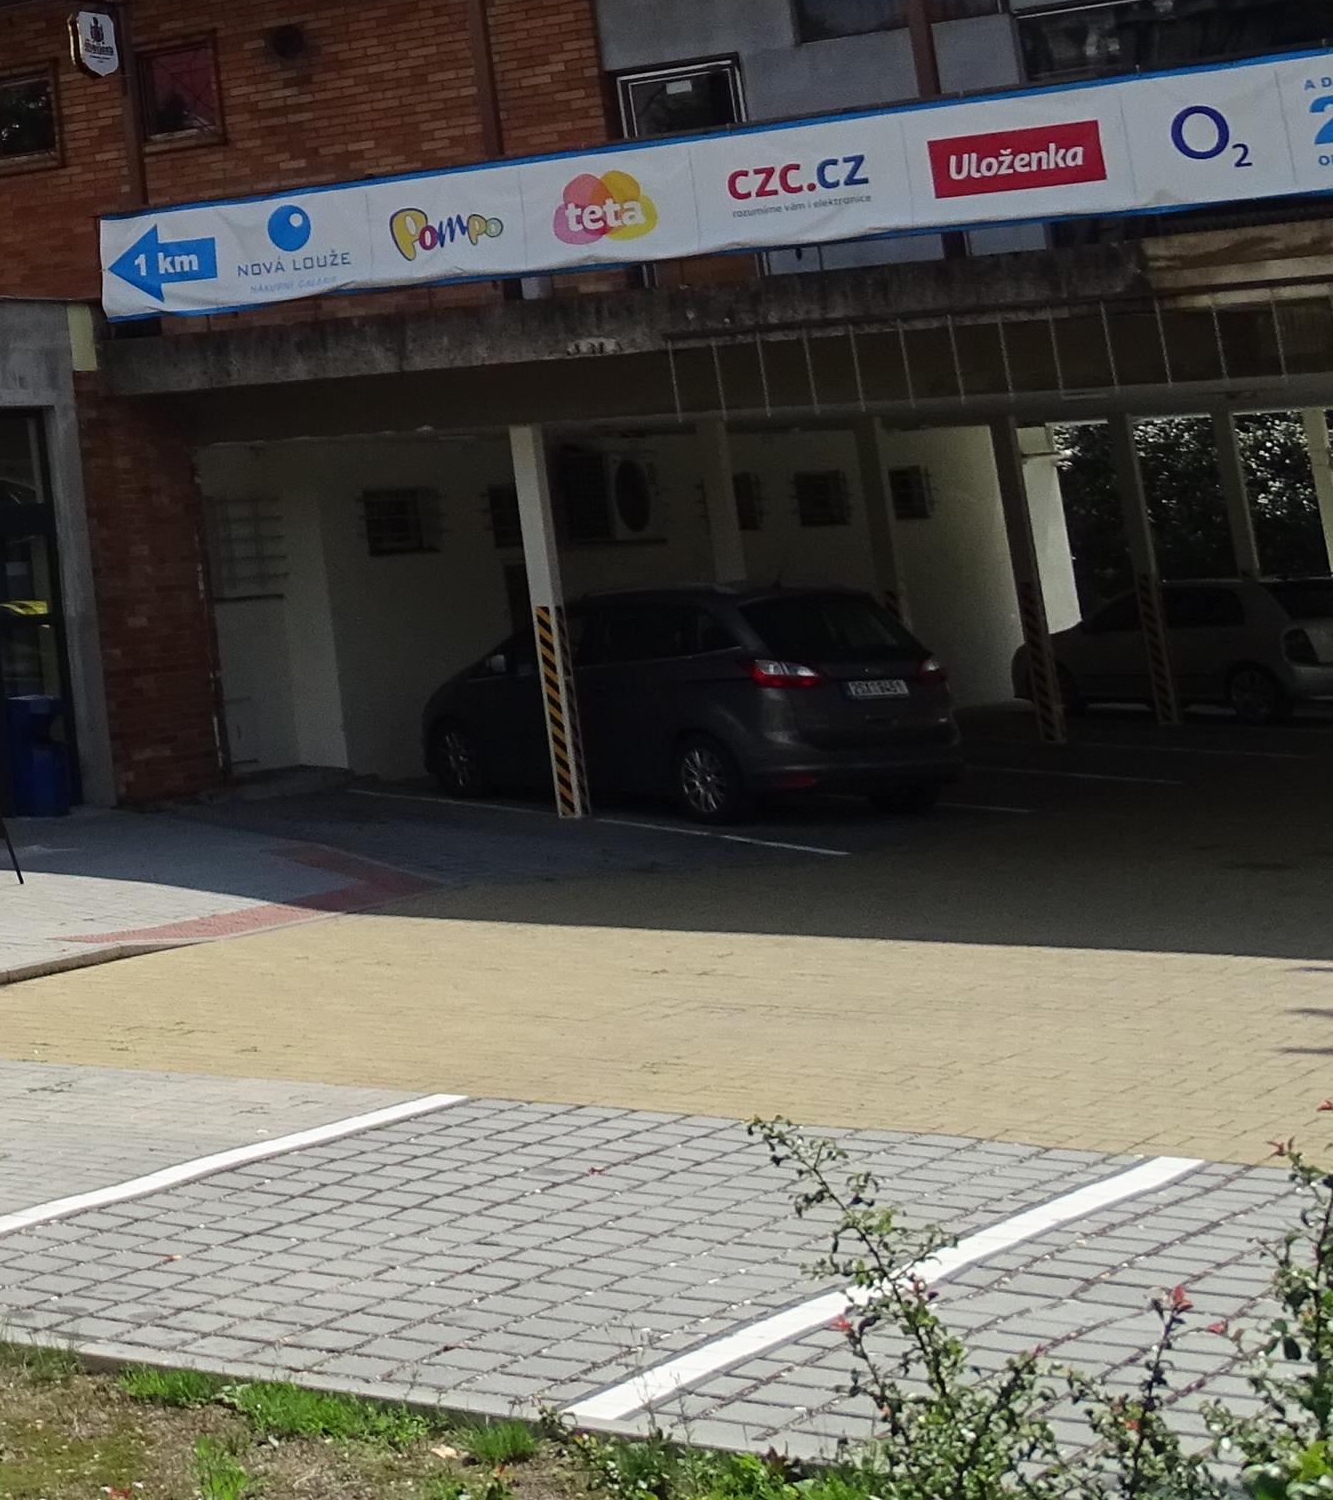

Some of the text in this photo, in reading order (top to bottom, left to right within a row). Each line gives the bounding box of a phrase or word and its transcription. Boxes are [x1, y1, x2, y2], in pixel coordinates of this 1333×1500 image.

[727, 154, 869, 200] CZC.CZ
[949, 143, 1085, 181] Uloženka
[564, 196, 644, 235] teta
[134, 251, 200, 275] 1 km
[237, 250, 352, 277] NOVÁ LOUŽE
